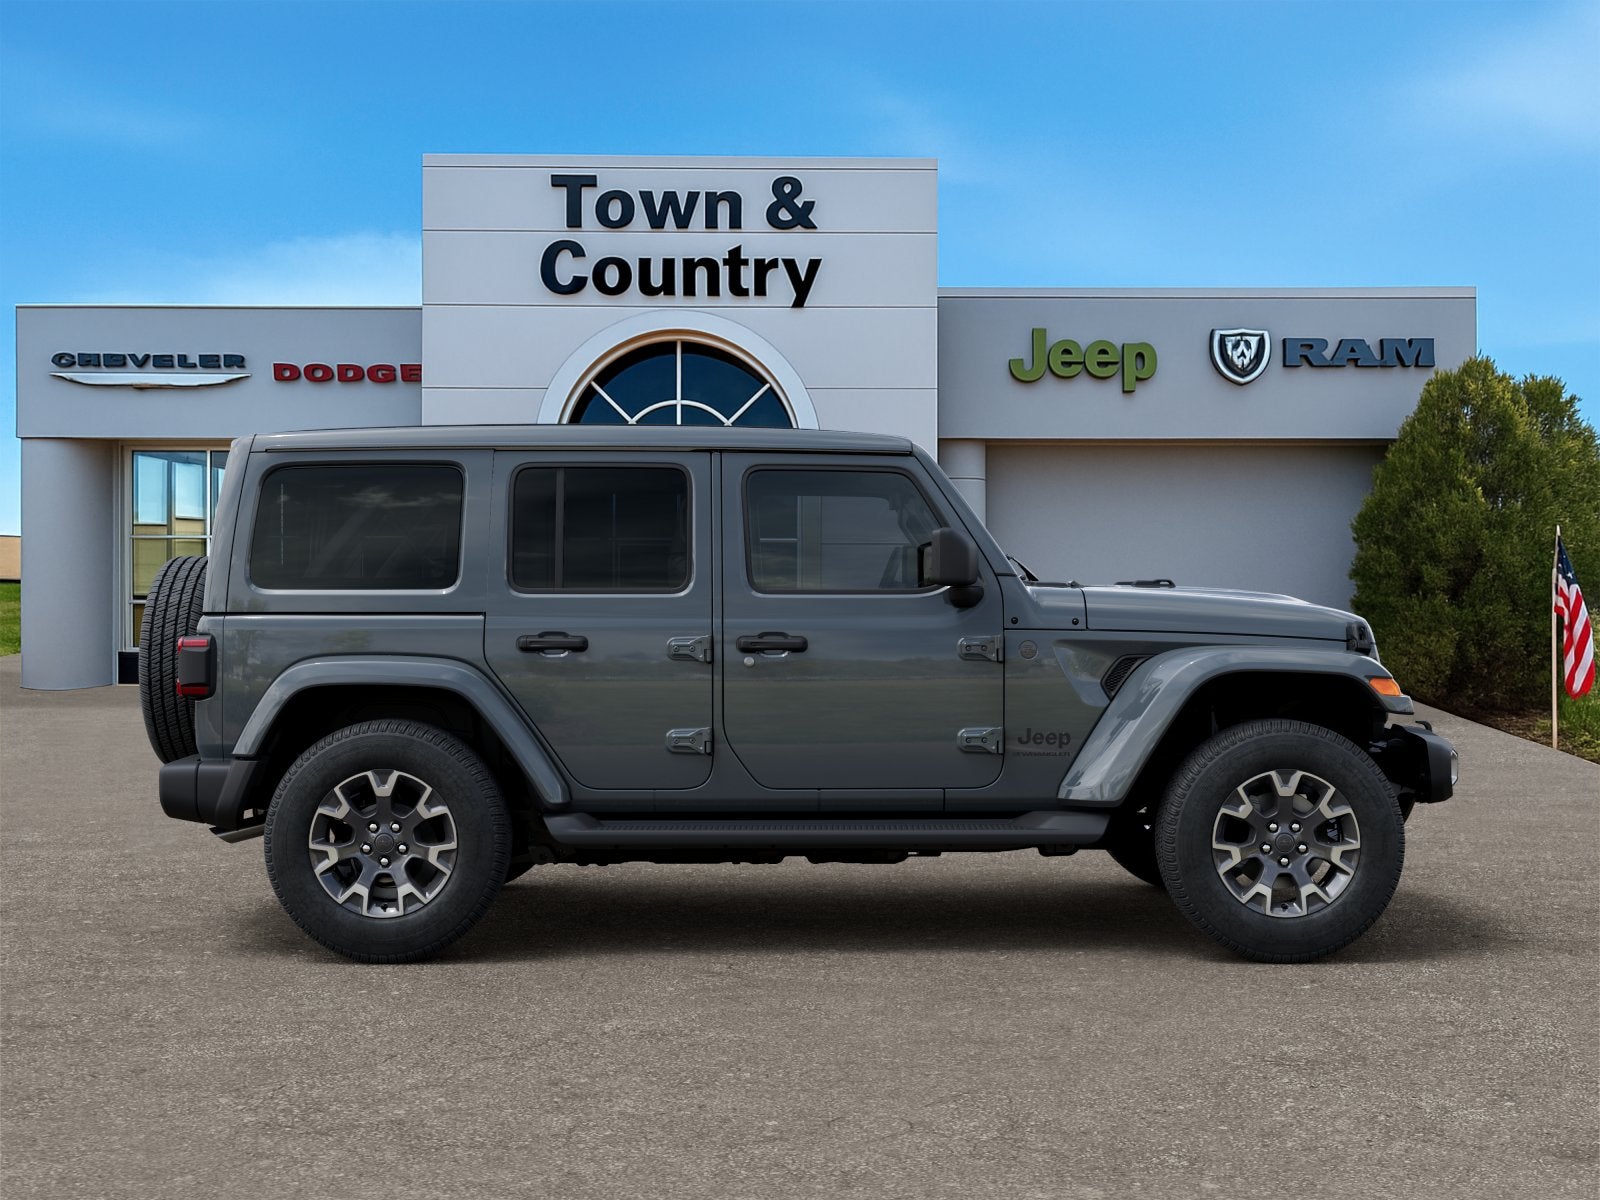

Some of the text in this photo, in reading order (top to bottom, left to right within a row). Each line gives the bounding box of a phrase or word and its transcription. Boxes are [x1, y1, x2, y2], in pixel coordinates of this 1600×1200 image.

[550, 174, 818, 230] Town &
[540, 239, 823, 308] Country
[273, 362, 422, 383] DODGE
[1008, 328, 1157, 392] Jeep
[1283, 337, 1435, 368] RAM
[1017, 727, 1071, 748] Jeep
